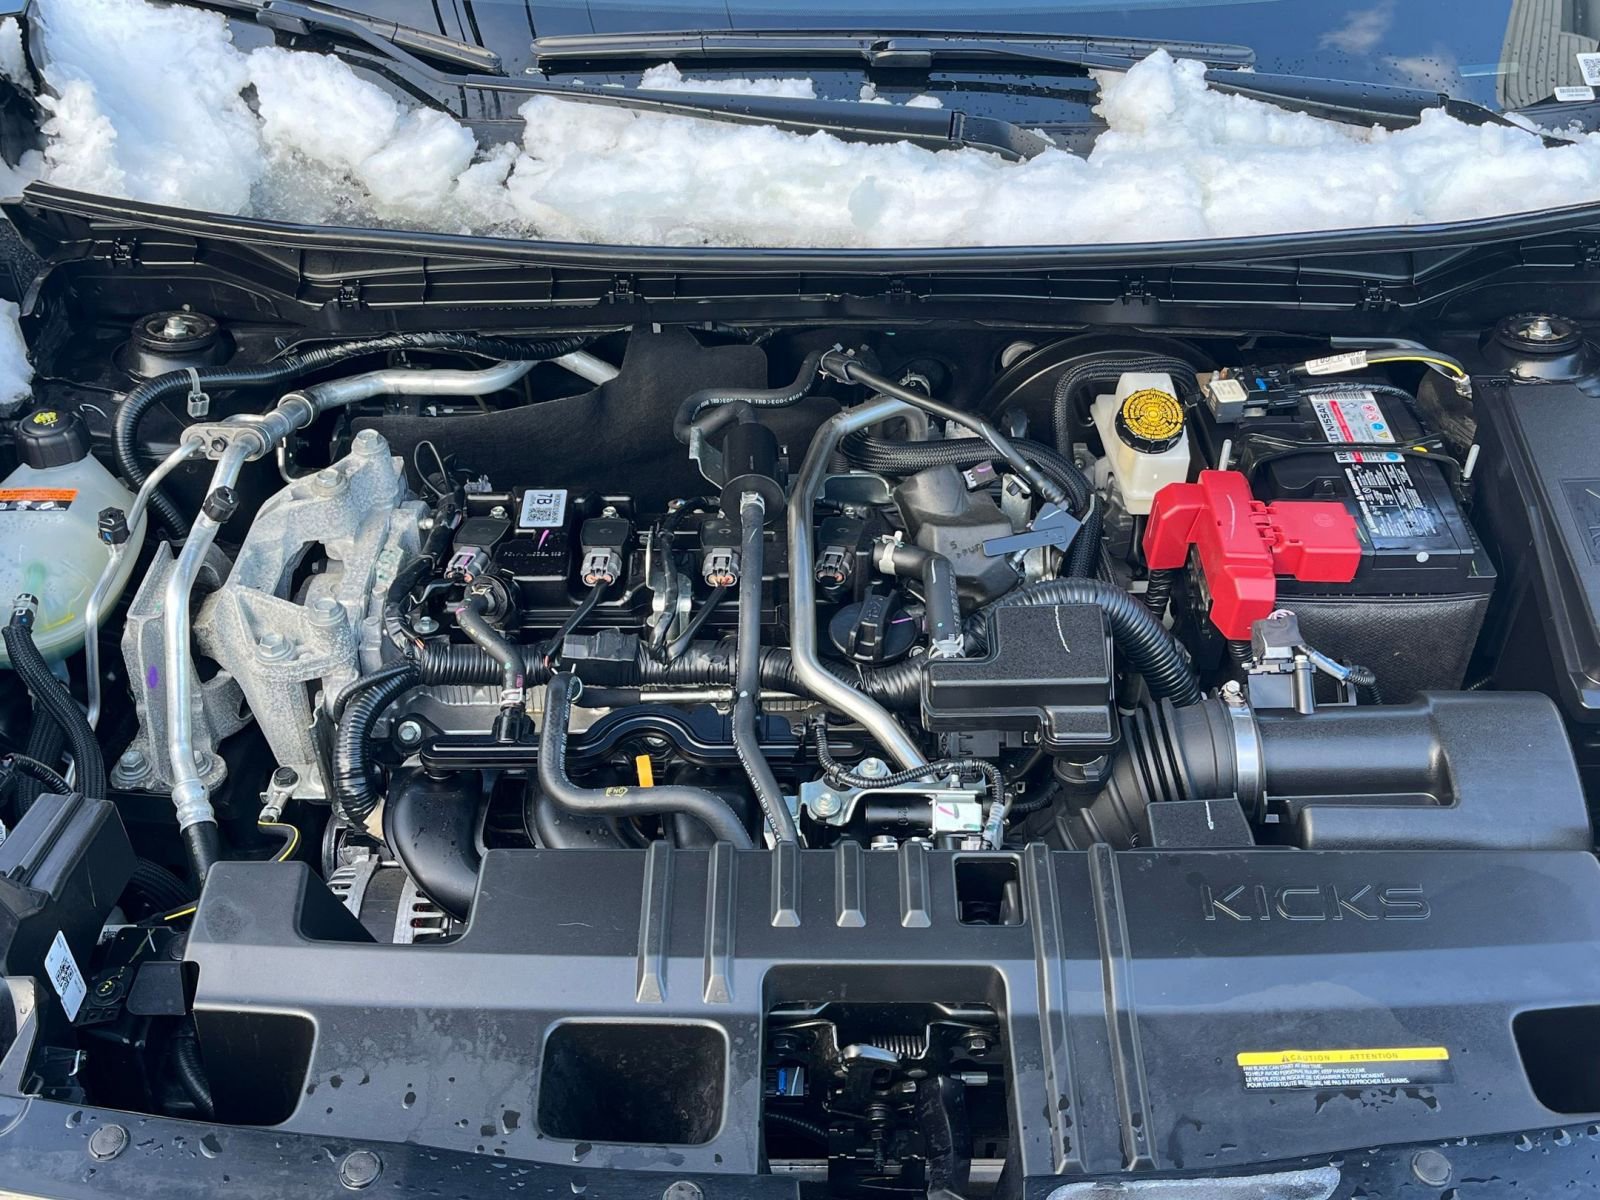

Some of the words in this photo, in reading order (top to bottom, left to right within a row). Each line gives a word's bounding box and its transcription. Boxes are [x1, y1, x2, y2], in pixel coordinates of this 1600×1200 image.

[1316, 403, 1335, 431] NISSAN
[1200, 882, 1432, 921] KICKS
[1290, 1053, 1331, 1062] CAUTION
[1350, 1052, 1399, 1061] ATTENTION
